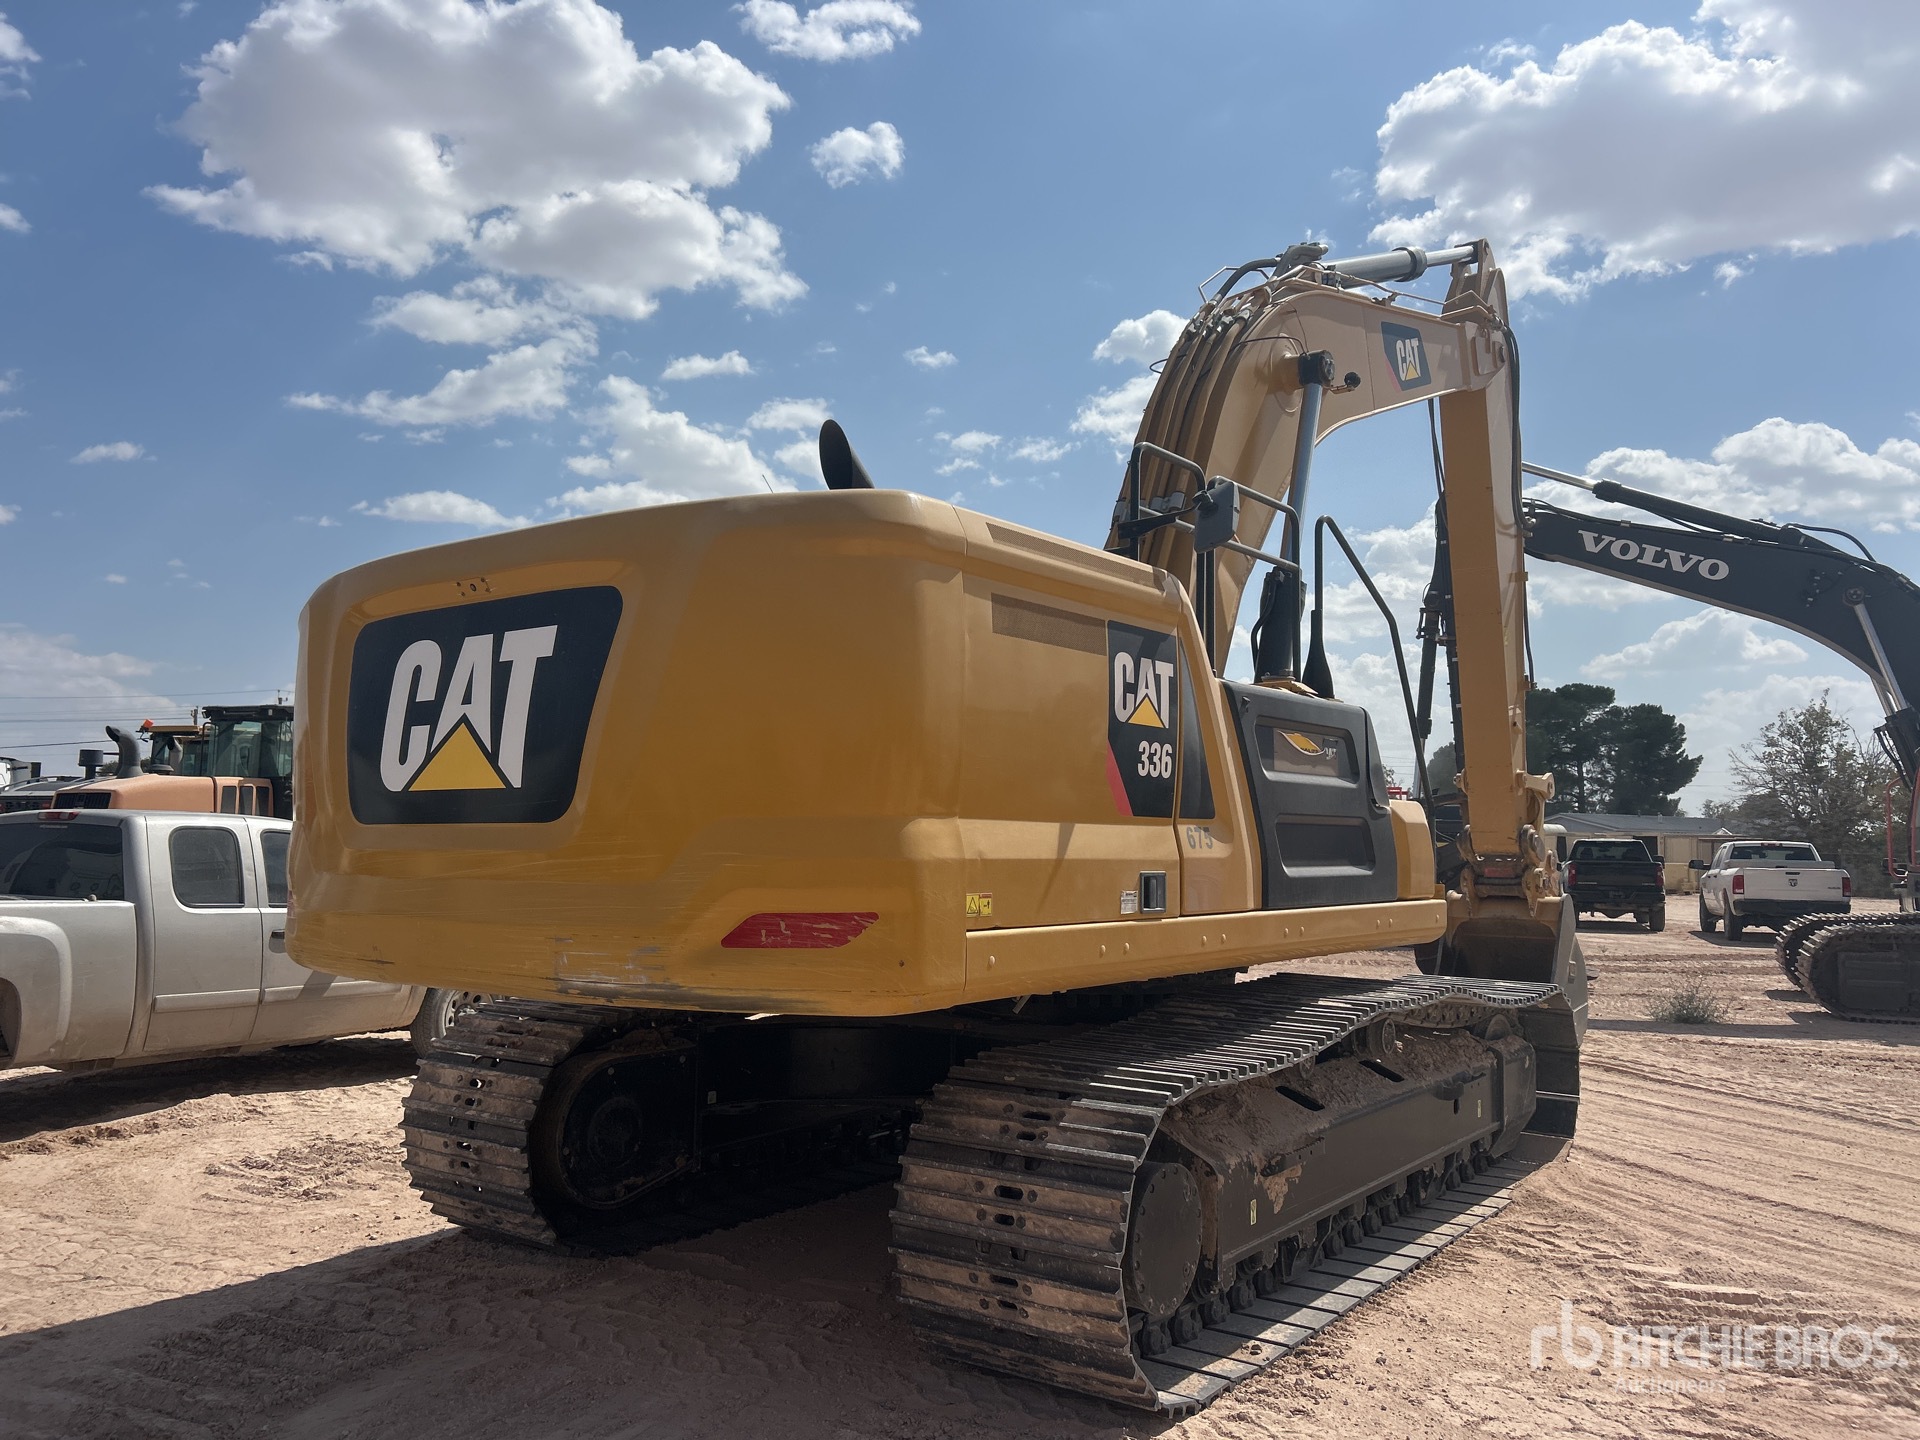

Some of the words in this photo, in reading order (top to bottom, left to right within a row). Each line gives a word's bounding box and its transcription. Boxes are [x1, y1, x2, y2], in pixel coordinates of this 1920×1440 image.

[1396, 338, 1421, 381] CAT
[1578, 530, 1730, 580] VOLVO
[380, 625, 558, 791] CAT
[1114, 651, 1174, 728] CAT
[1137, 740, 1172, 779] 336
[1186, 827, 1213, 850] 675
